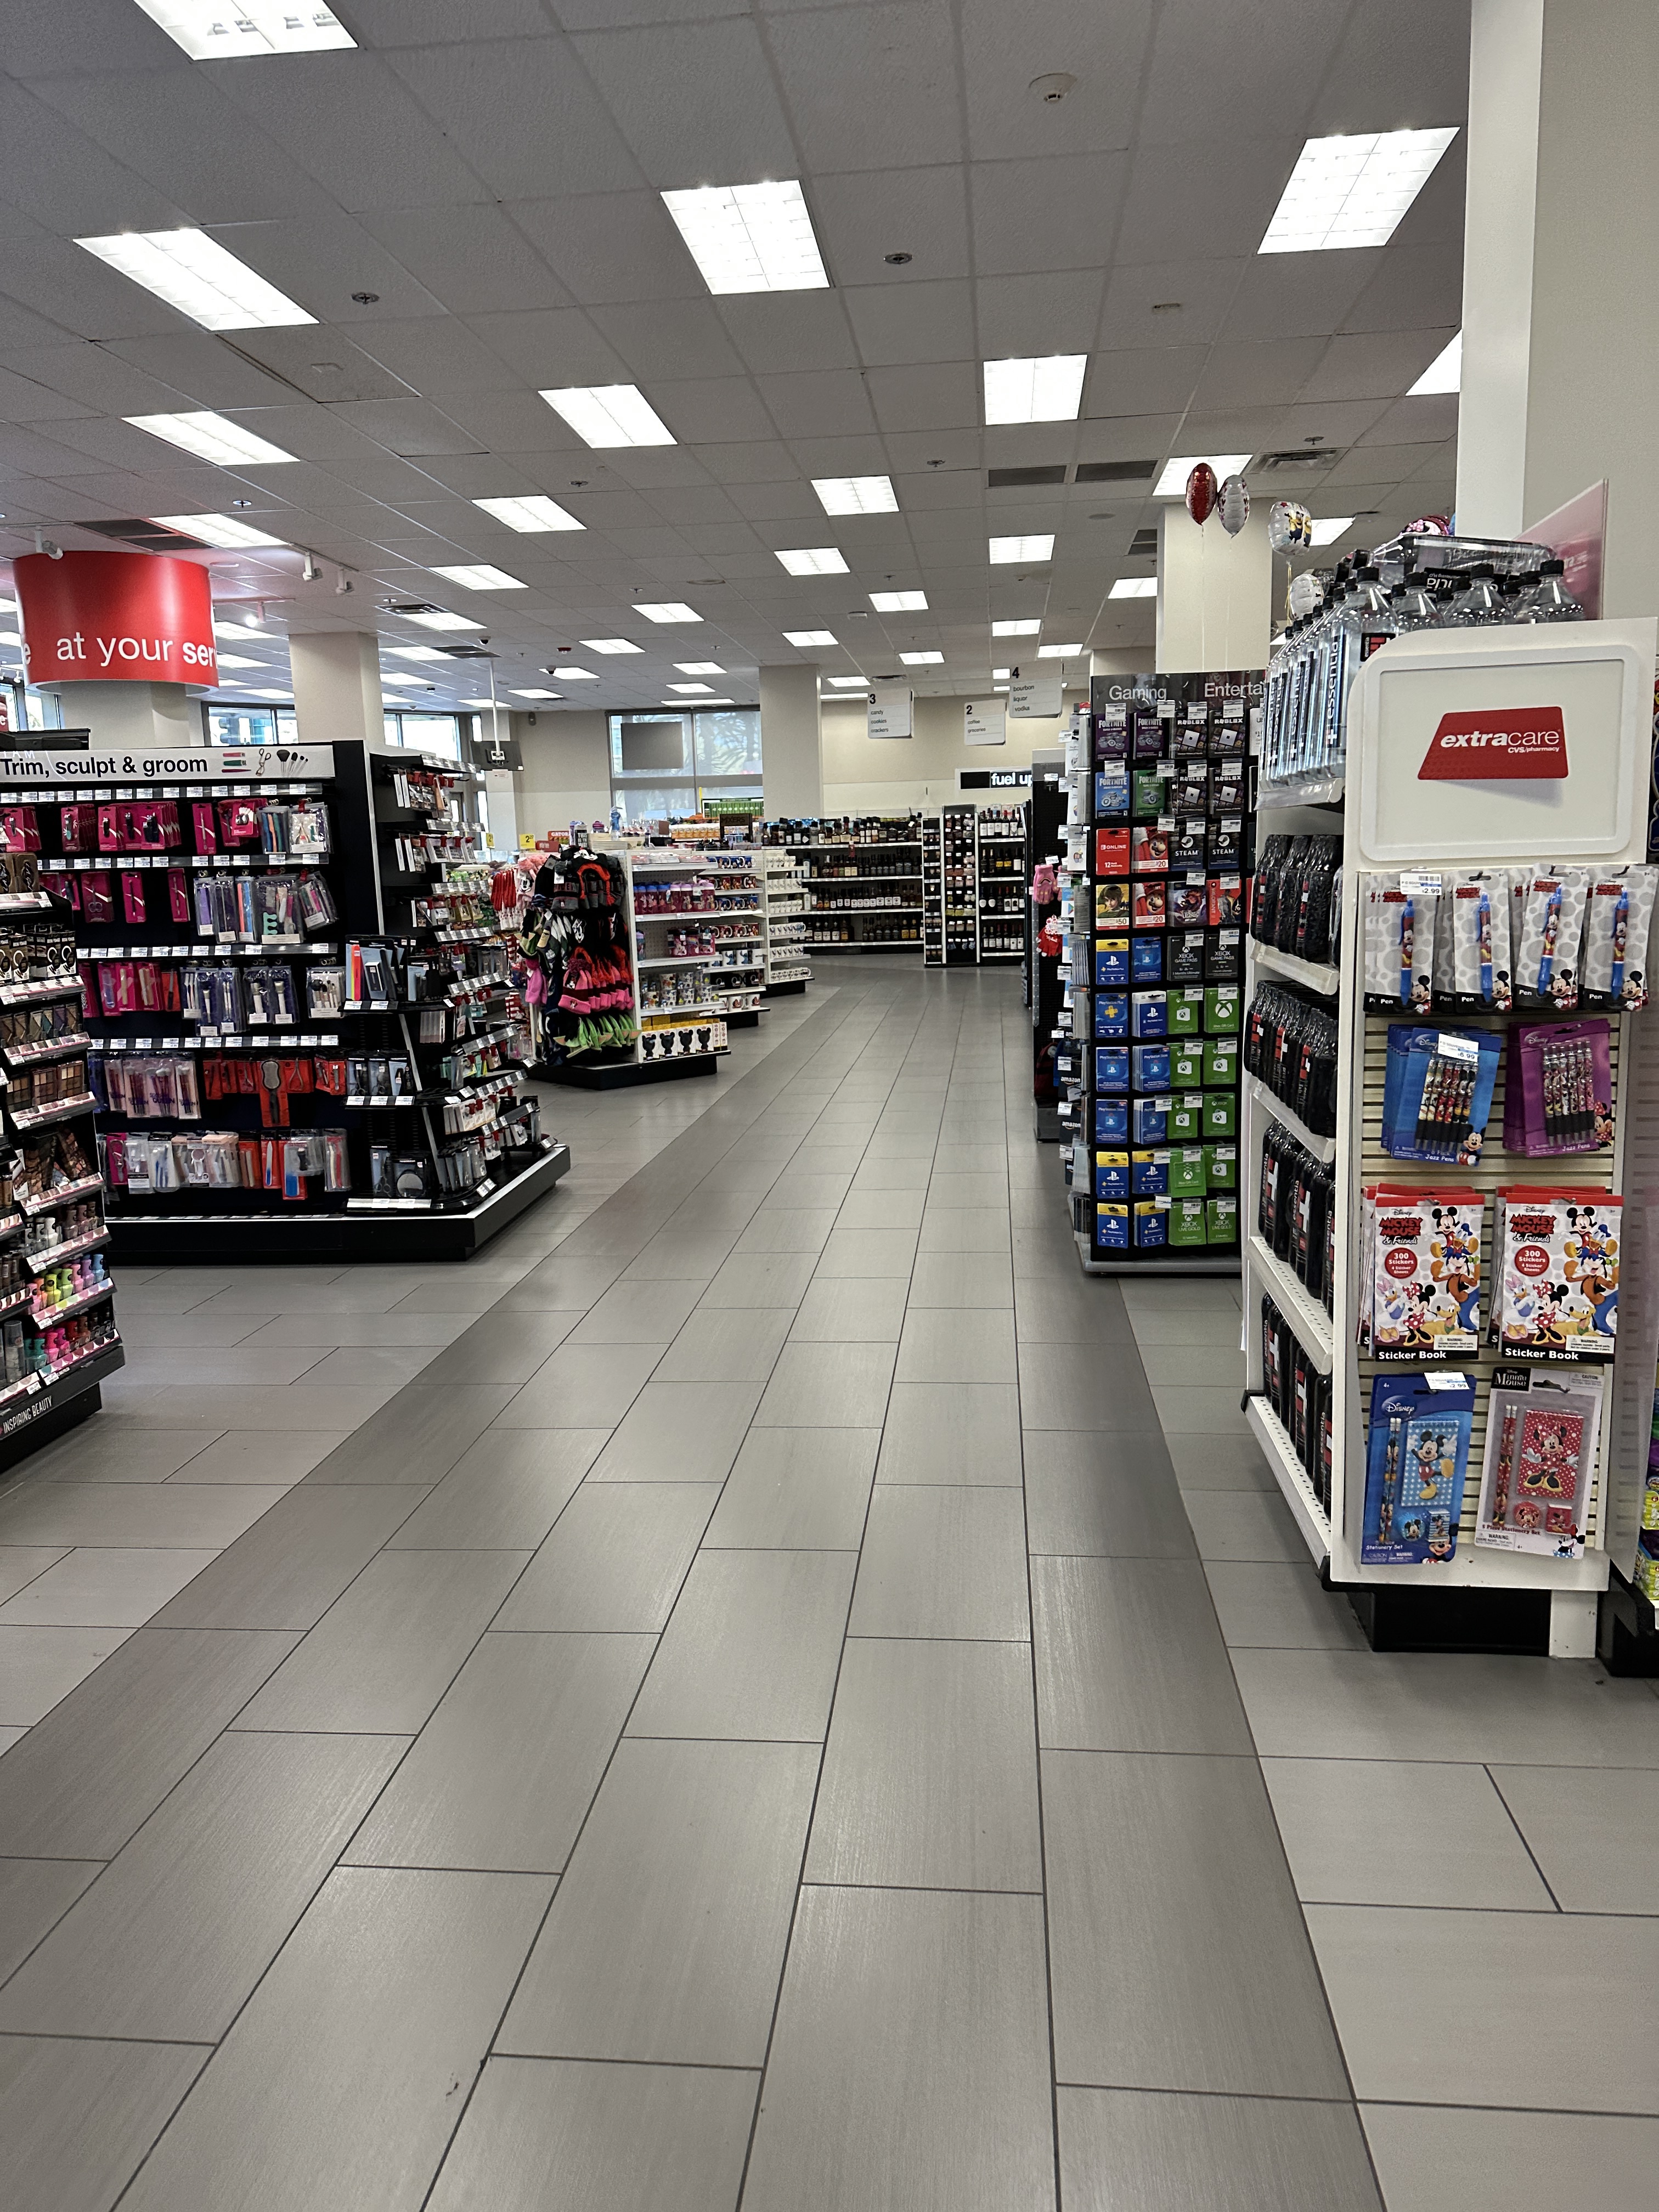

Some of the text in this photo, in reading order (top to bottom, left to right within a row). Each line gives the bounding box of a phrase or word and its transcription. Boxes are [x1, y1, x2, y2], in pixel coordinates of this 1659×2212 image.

[57, 632, 87, 661] at
[97, 637, 173, 667] your
[1012, 667, 1020, 679] 4
[1109, 685, 1167, 701] Gaming
[869, 693, 877, 704] 3
[966, 705, 973, 715] 2
[1099, 719, 1126, 728] FORTNITE
[1138, 718, 1163, 726] FORTNITE
[1441, 731, 1559, 748] extracare
[0, 756, 208, 780] Trim, sculpt & groom
[991, 772, 1016, 786] fuel
[1099, 777, 1127, 786] FORTNITE
[1391, 1209, 1413, 1217] Disney
[1523, 1205, 1545, 1214] Disney
[1379, 1217, 1424, 1228] MICKEY
[1509, 1214, 1558, 1226] MICKEY
[1380, 1226, 1421, 1237] MOUSE
[1510, 1224, 1554, 1234] MOUSE
[1383, 1235, 1418, 1245] & Friends
[1513, 1233, 1551, 1243] & Friends
[1379, 1350, 1447, 1359] Sticker Book
[1505, 1347, 1579, 1360] Sticker Book
[1495, 1373, 1527, 1382] Minnie
[1495, 1377, 1526, 1386] Mouse
[1386, 1402, 1415, 1415] Disney
[3, 1396, 52, 1434] INSPIRING BEAUTY
[1502, 1526, 1530, 1534] Stationery
